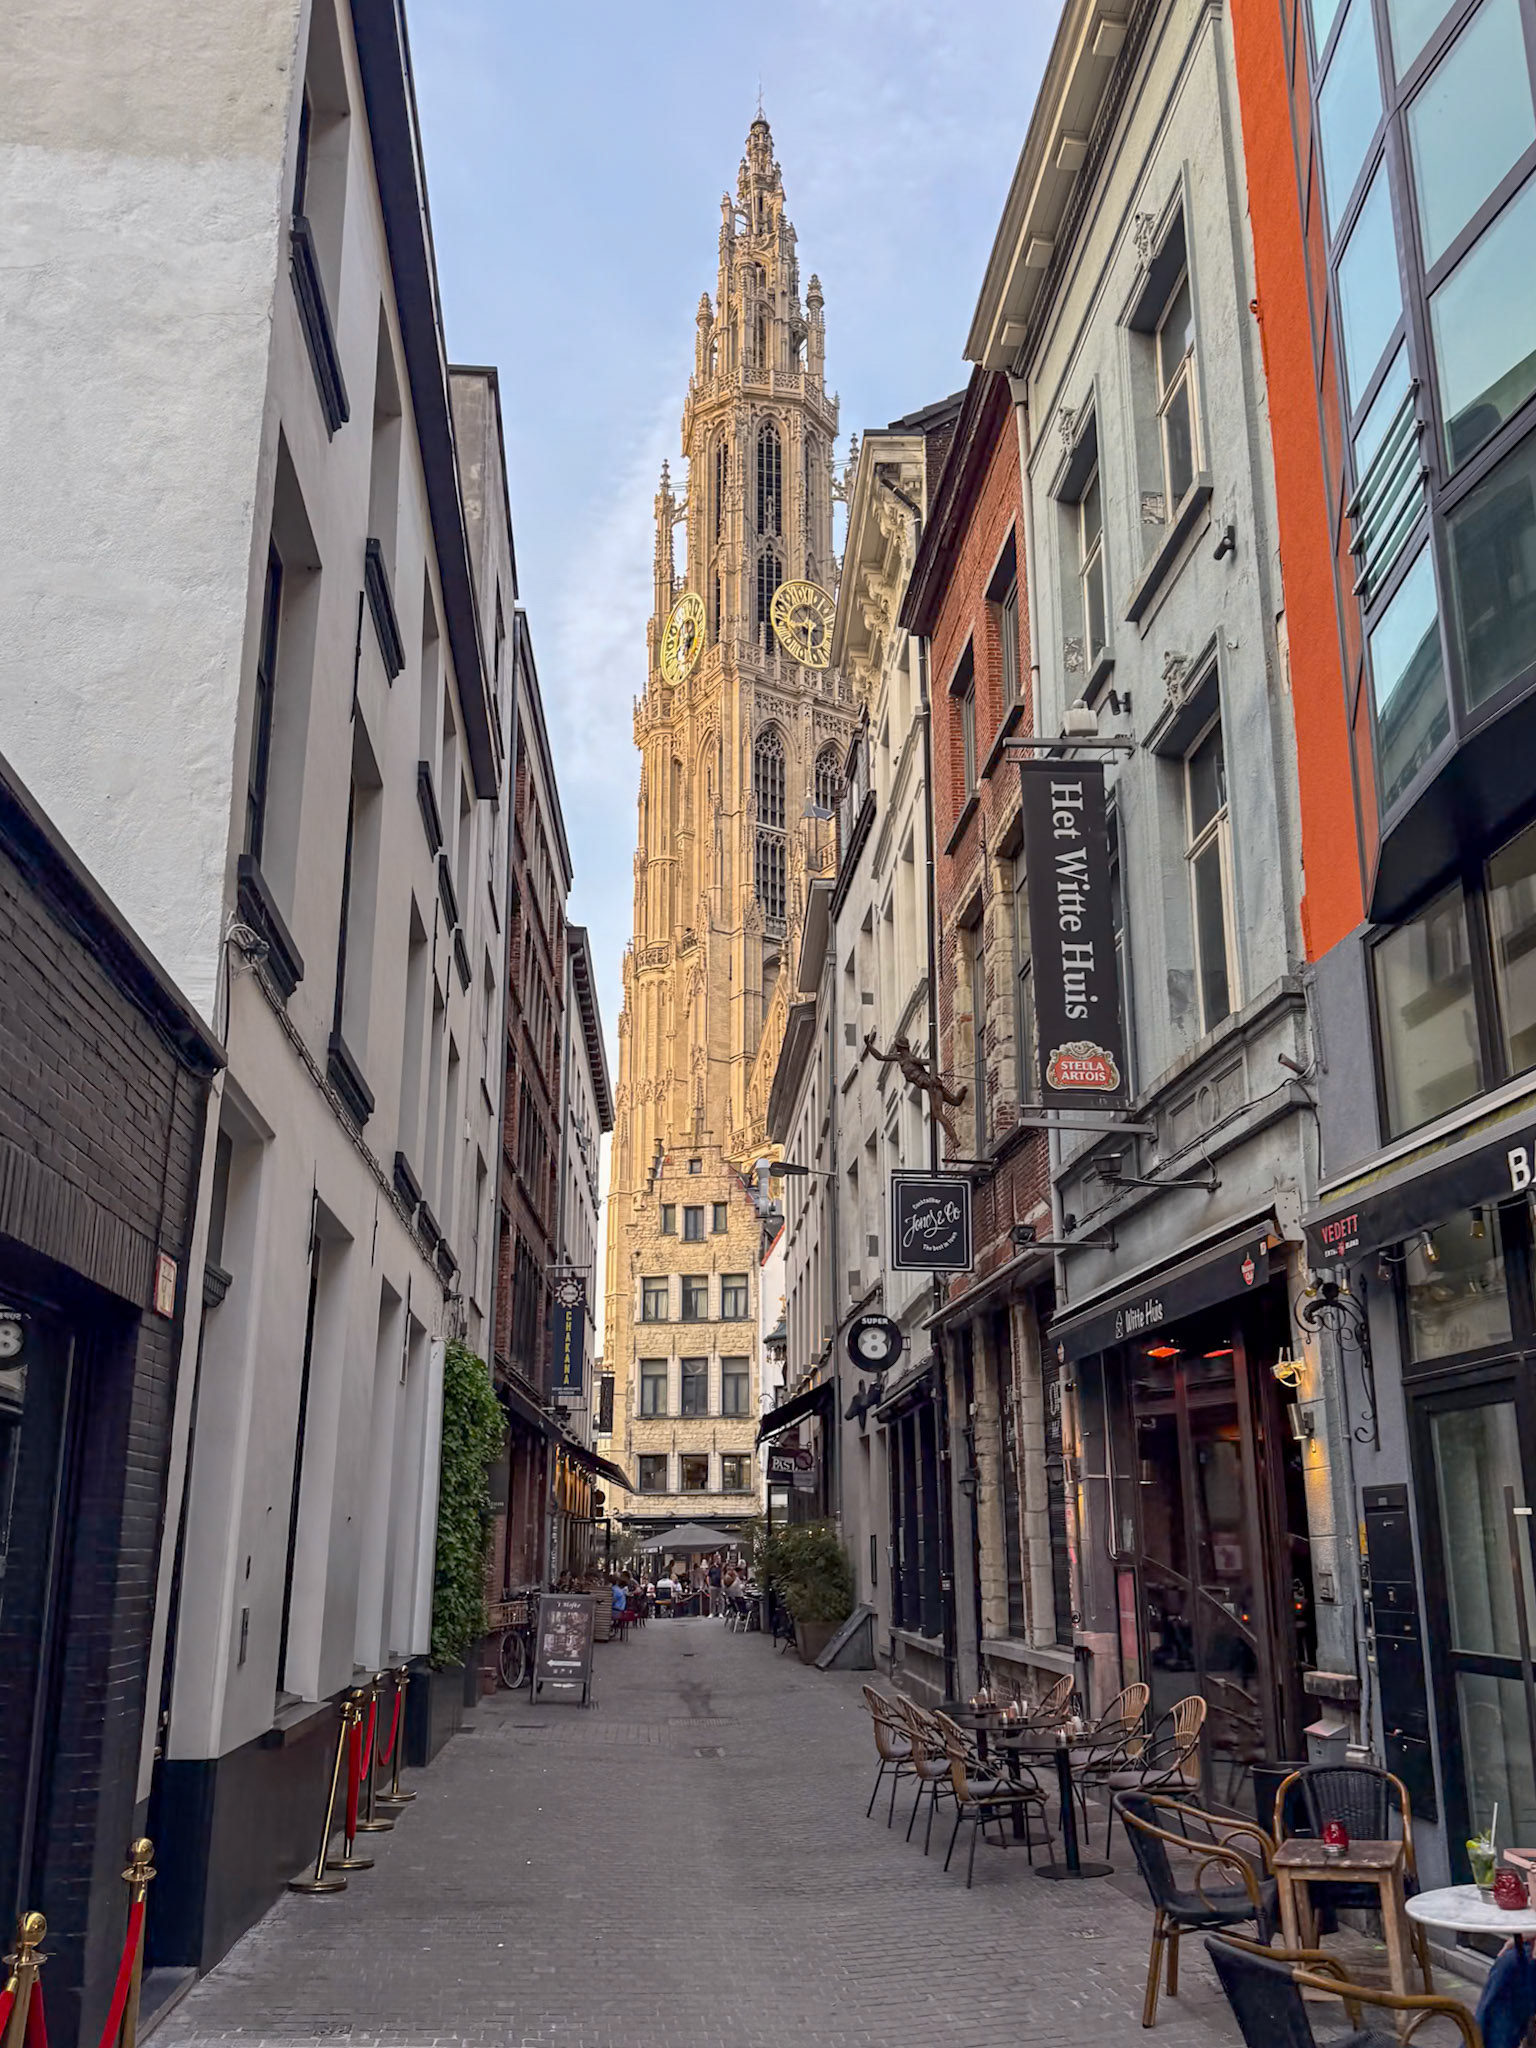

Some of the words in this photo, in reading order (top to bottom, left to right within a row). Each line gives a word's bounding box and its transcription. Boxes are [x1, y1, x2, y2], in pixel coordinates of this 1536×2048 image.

[1050, 781, 1084, 840] Het
[1054, 847, 1091, 932] Witte
[1060, 940, 1099, 1019] Huis
[1060, 1061, 1105, 1071] STELLA
[1061, 1071, 1106, 1081] ARTOIS
[1507, 1146, 1536, 1191] B
[1321, 1214, 1358, 1244] VEDETT
[861, 1317, 889, 1325] SUPER
[563, 1311, 573, 1385] CHAKANA
[861, 1327, 888, 1359] 8
